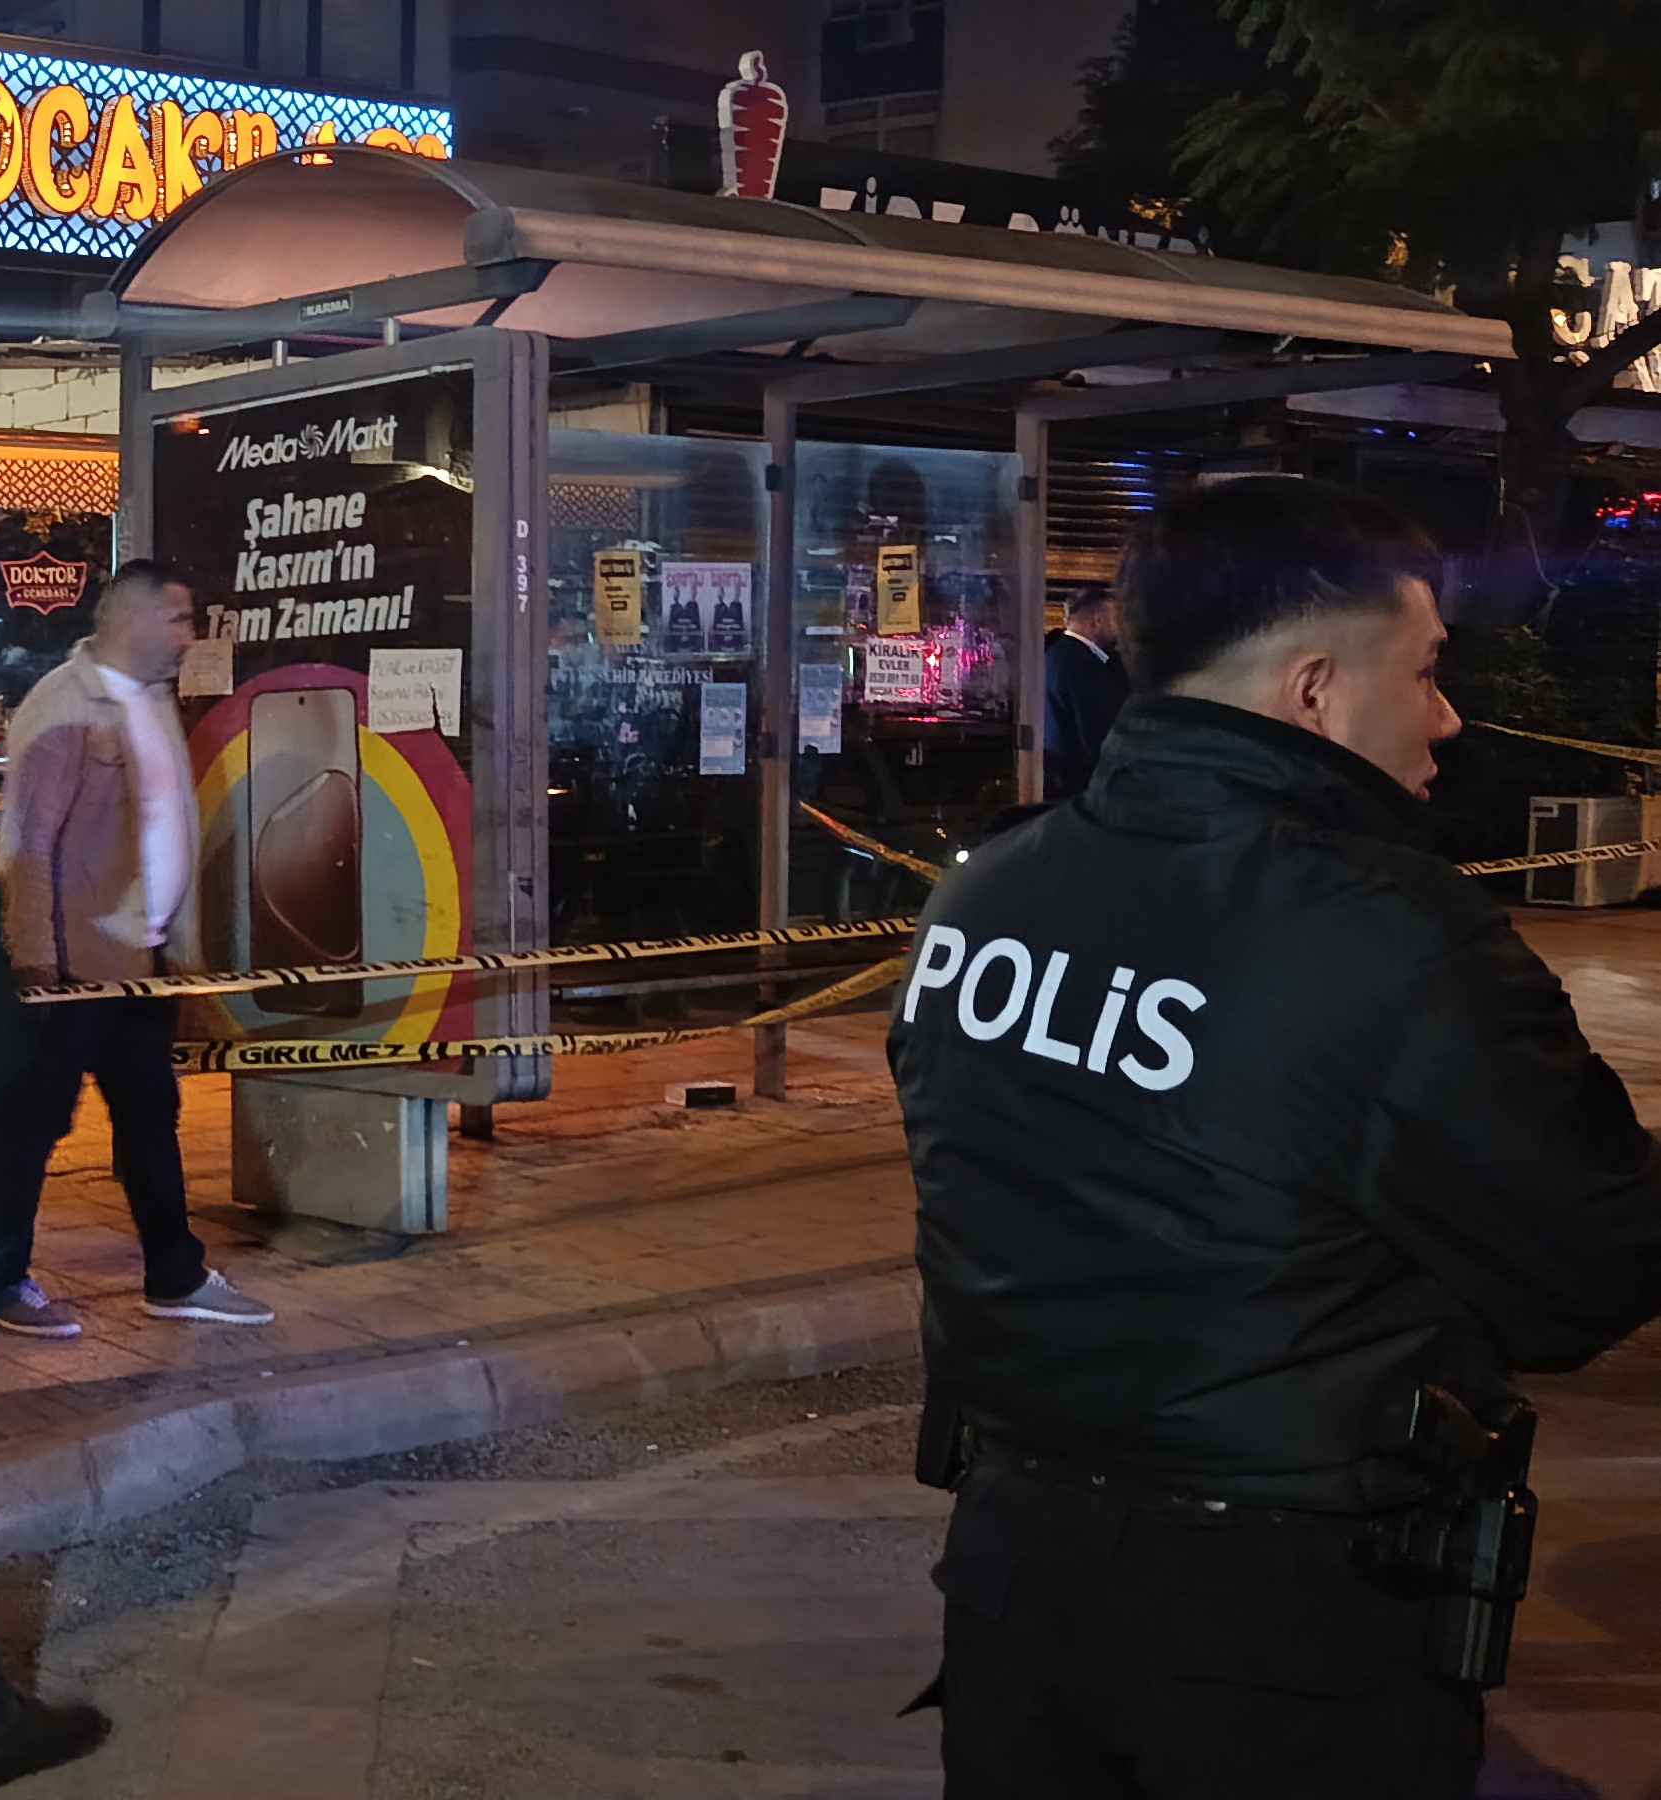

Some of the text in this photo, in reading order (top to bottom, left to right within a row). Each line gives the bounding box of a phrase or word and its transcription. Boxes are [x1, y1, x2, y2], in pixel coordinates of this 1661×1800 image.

[306, 299, 349, 316] KARMA
[216, 414, 398, 472] Media Markt
[244, 491, 367, 549] Şahane
[516, 519, 529, 539] D
[10, 566, 78, 585] DOKTOR
[234, 540, 376, 592] Kasım'ın
[206, 585, 415, 643] Tam Zamanı!
